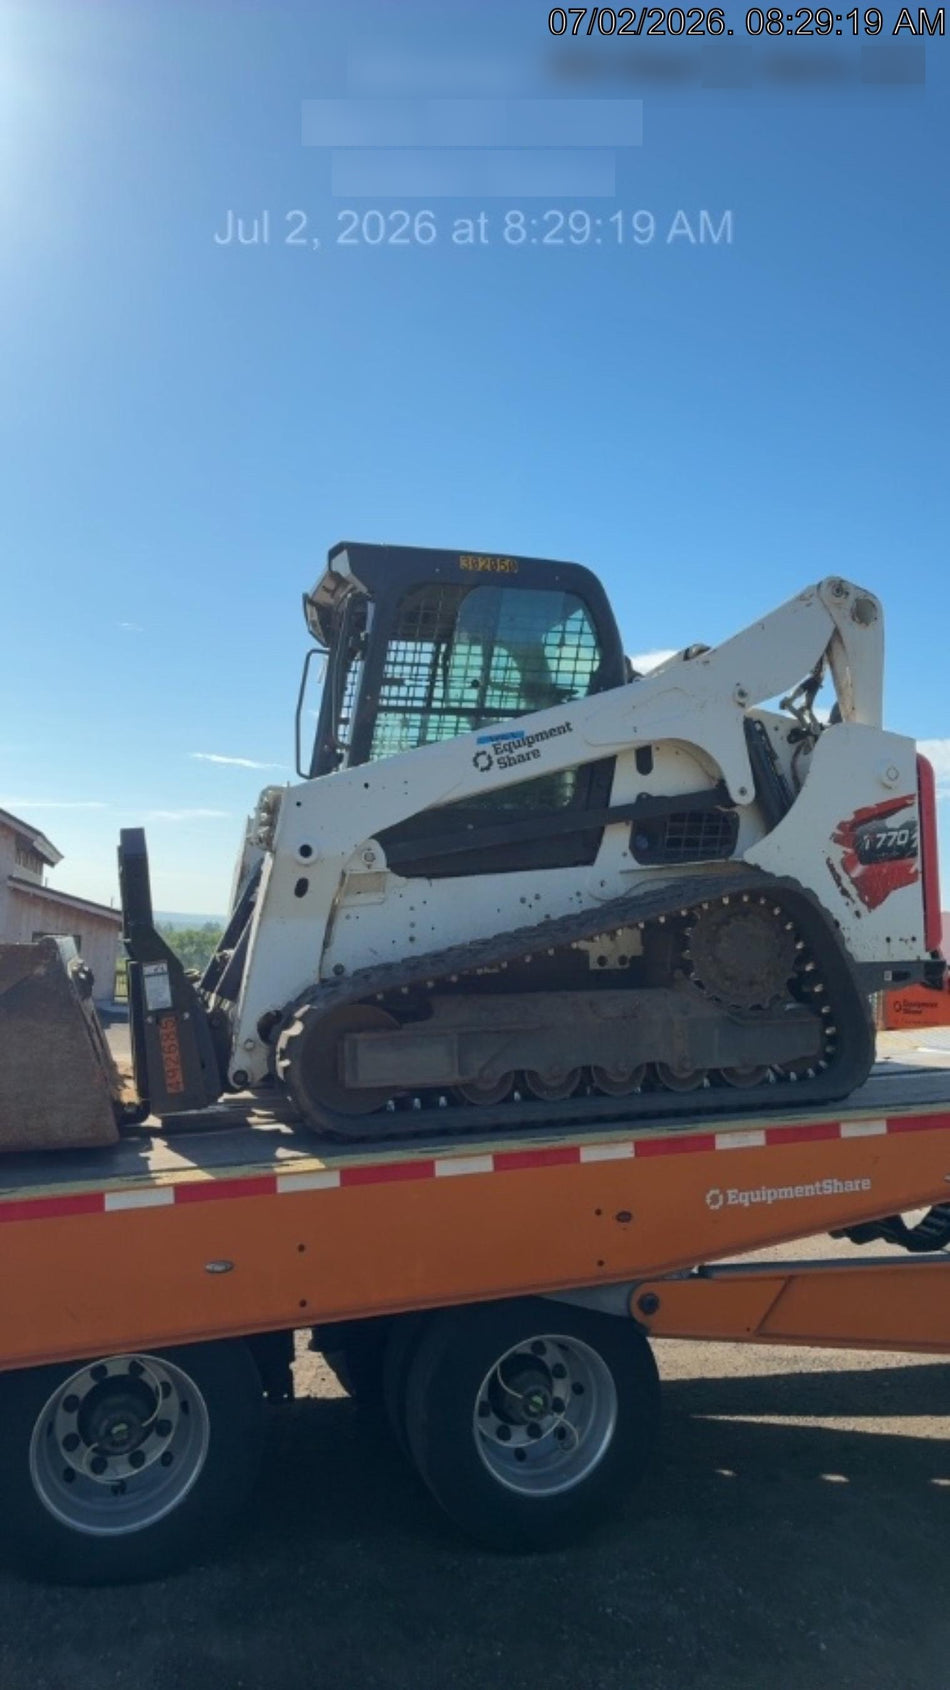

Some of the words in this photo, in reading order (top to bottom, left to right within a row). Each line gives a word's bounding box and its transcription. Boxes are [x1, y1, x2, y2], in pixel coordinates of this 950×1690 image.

[492, 721, 574, 756] Equipment
[496, 748, 542, 770] Share
[726, 1178, 872, 1207] EquipmentShare
